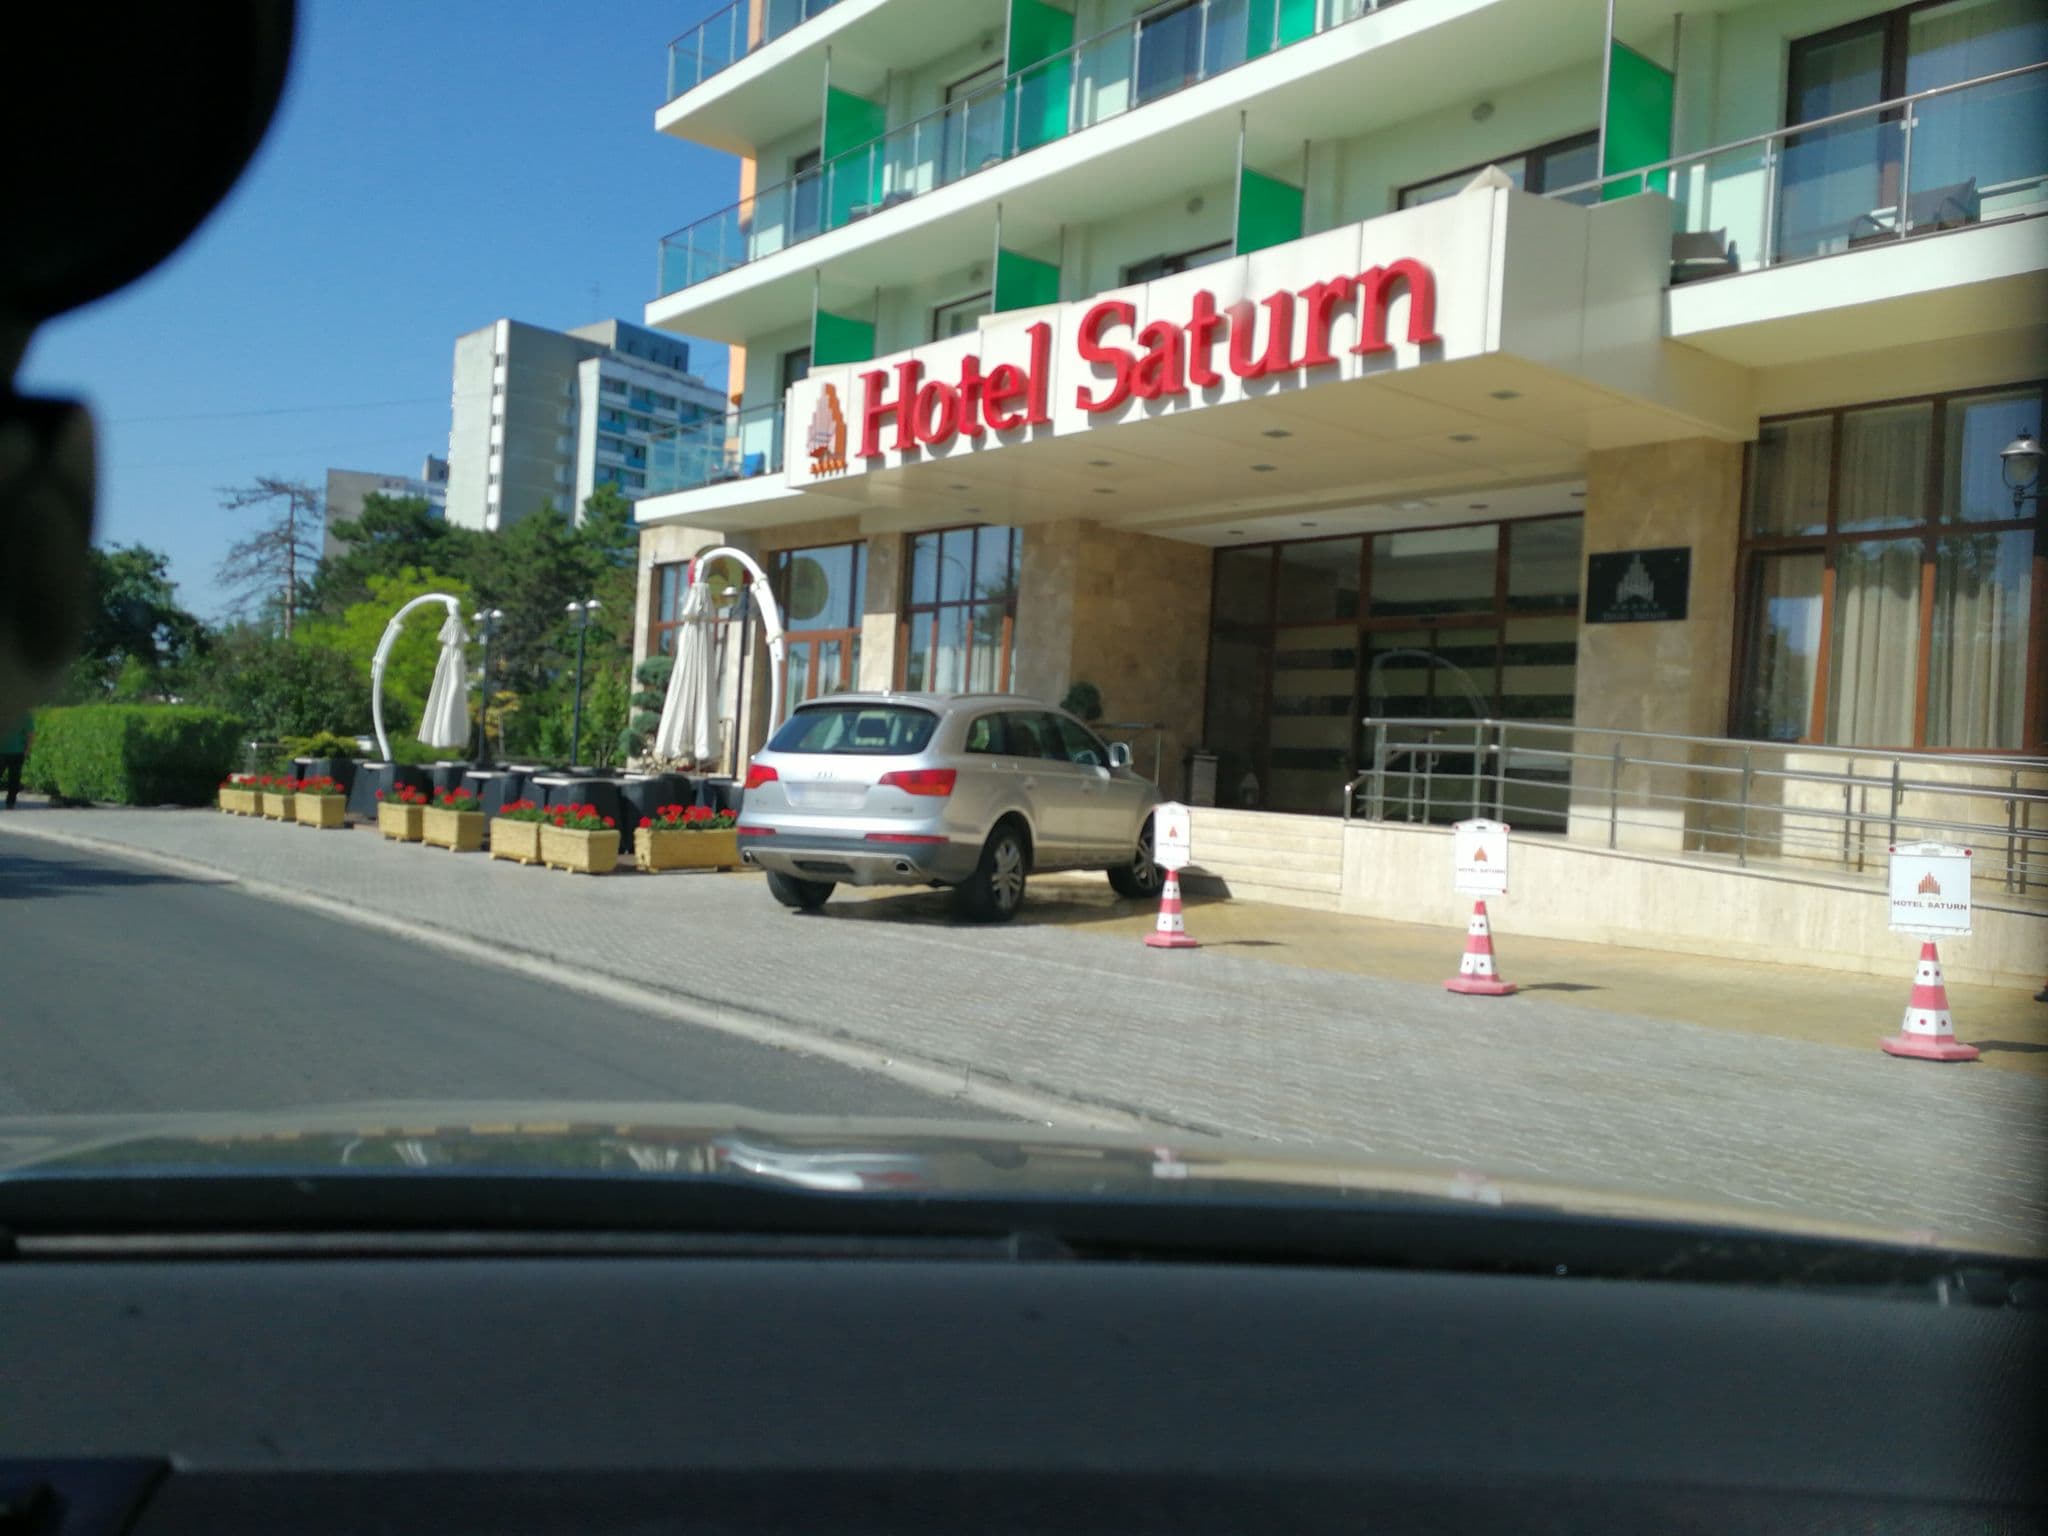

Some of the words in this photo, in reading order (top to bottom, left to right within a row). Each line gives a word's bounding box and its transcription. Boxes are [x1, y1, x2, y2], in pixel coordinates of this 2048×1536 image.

[856, 321, 1051, 459] Hotel
[1075, 256, 1439, 415] Saturn
[1893, 900, 1924, 908] HOTEL
[1928, 901, 1967, 910] SATURN
